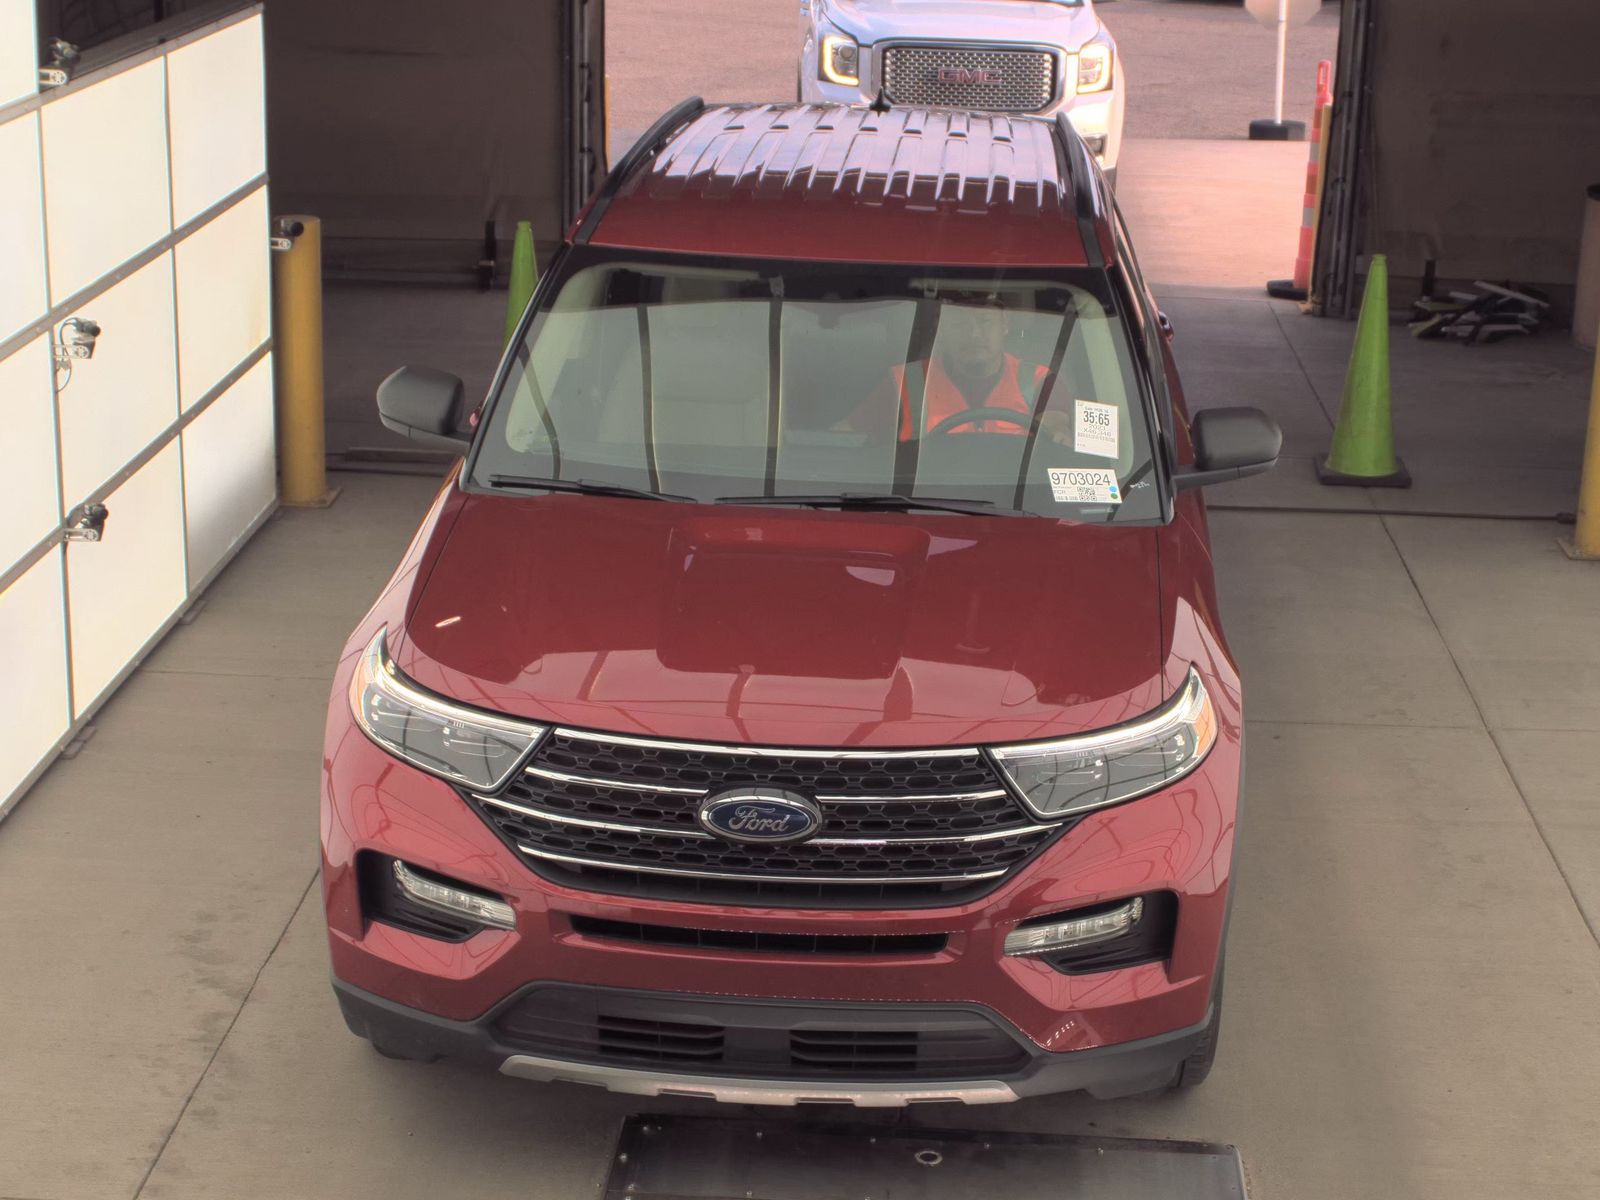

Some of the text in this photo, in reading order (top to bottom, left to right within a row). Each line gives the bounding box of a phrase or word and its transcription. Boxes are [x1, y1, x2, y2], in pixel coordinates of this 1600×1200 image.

[937, 67, 1003, 84] GMC
[1083, 410, 1110, 426] 35:65
[1051, 472, 1111, 486] 9703024
[728, 804, 791, 832] Ford
